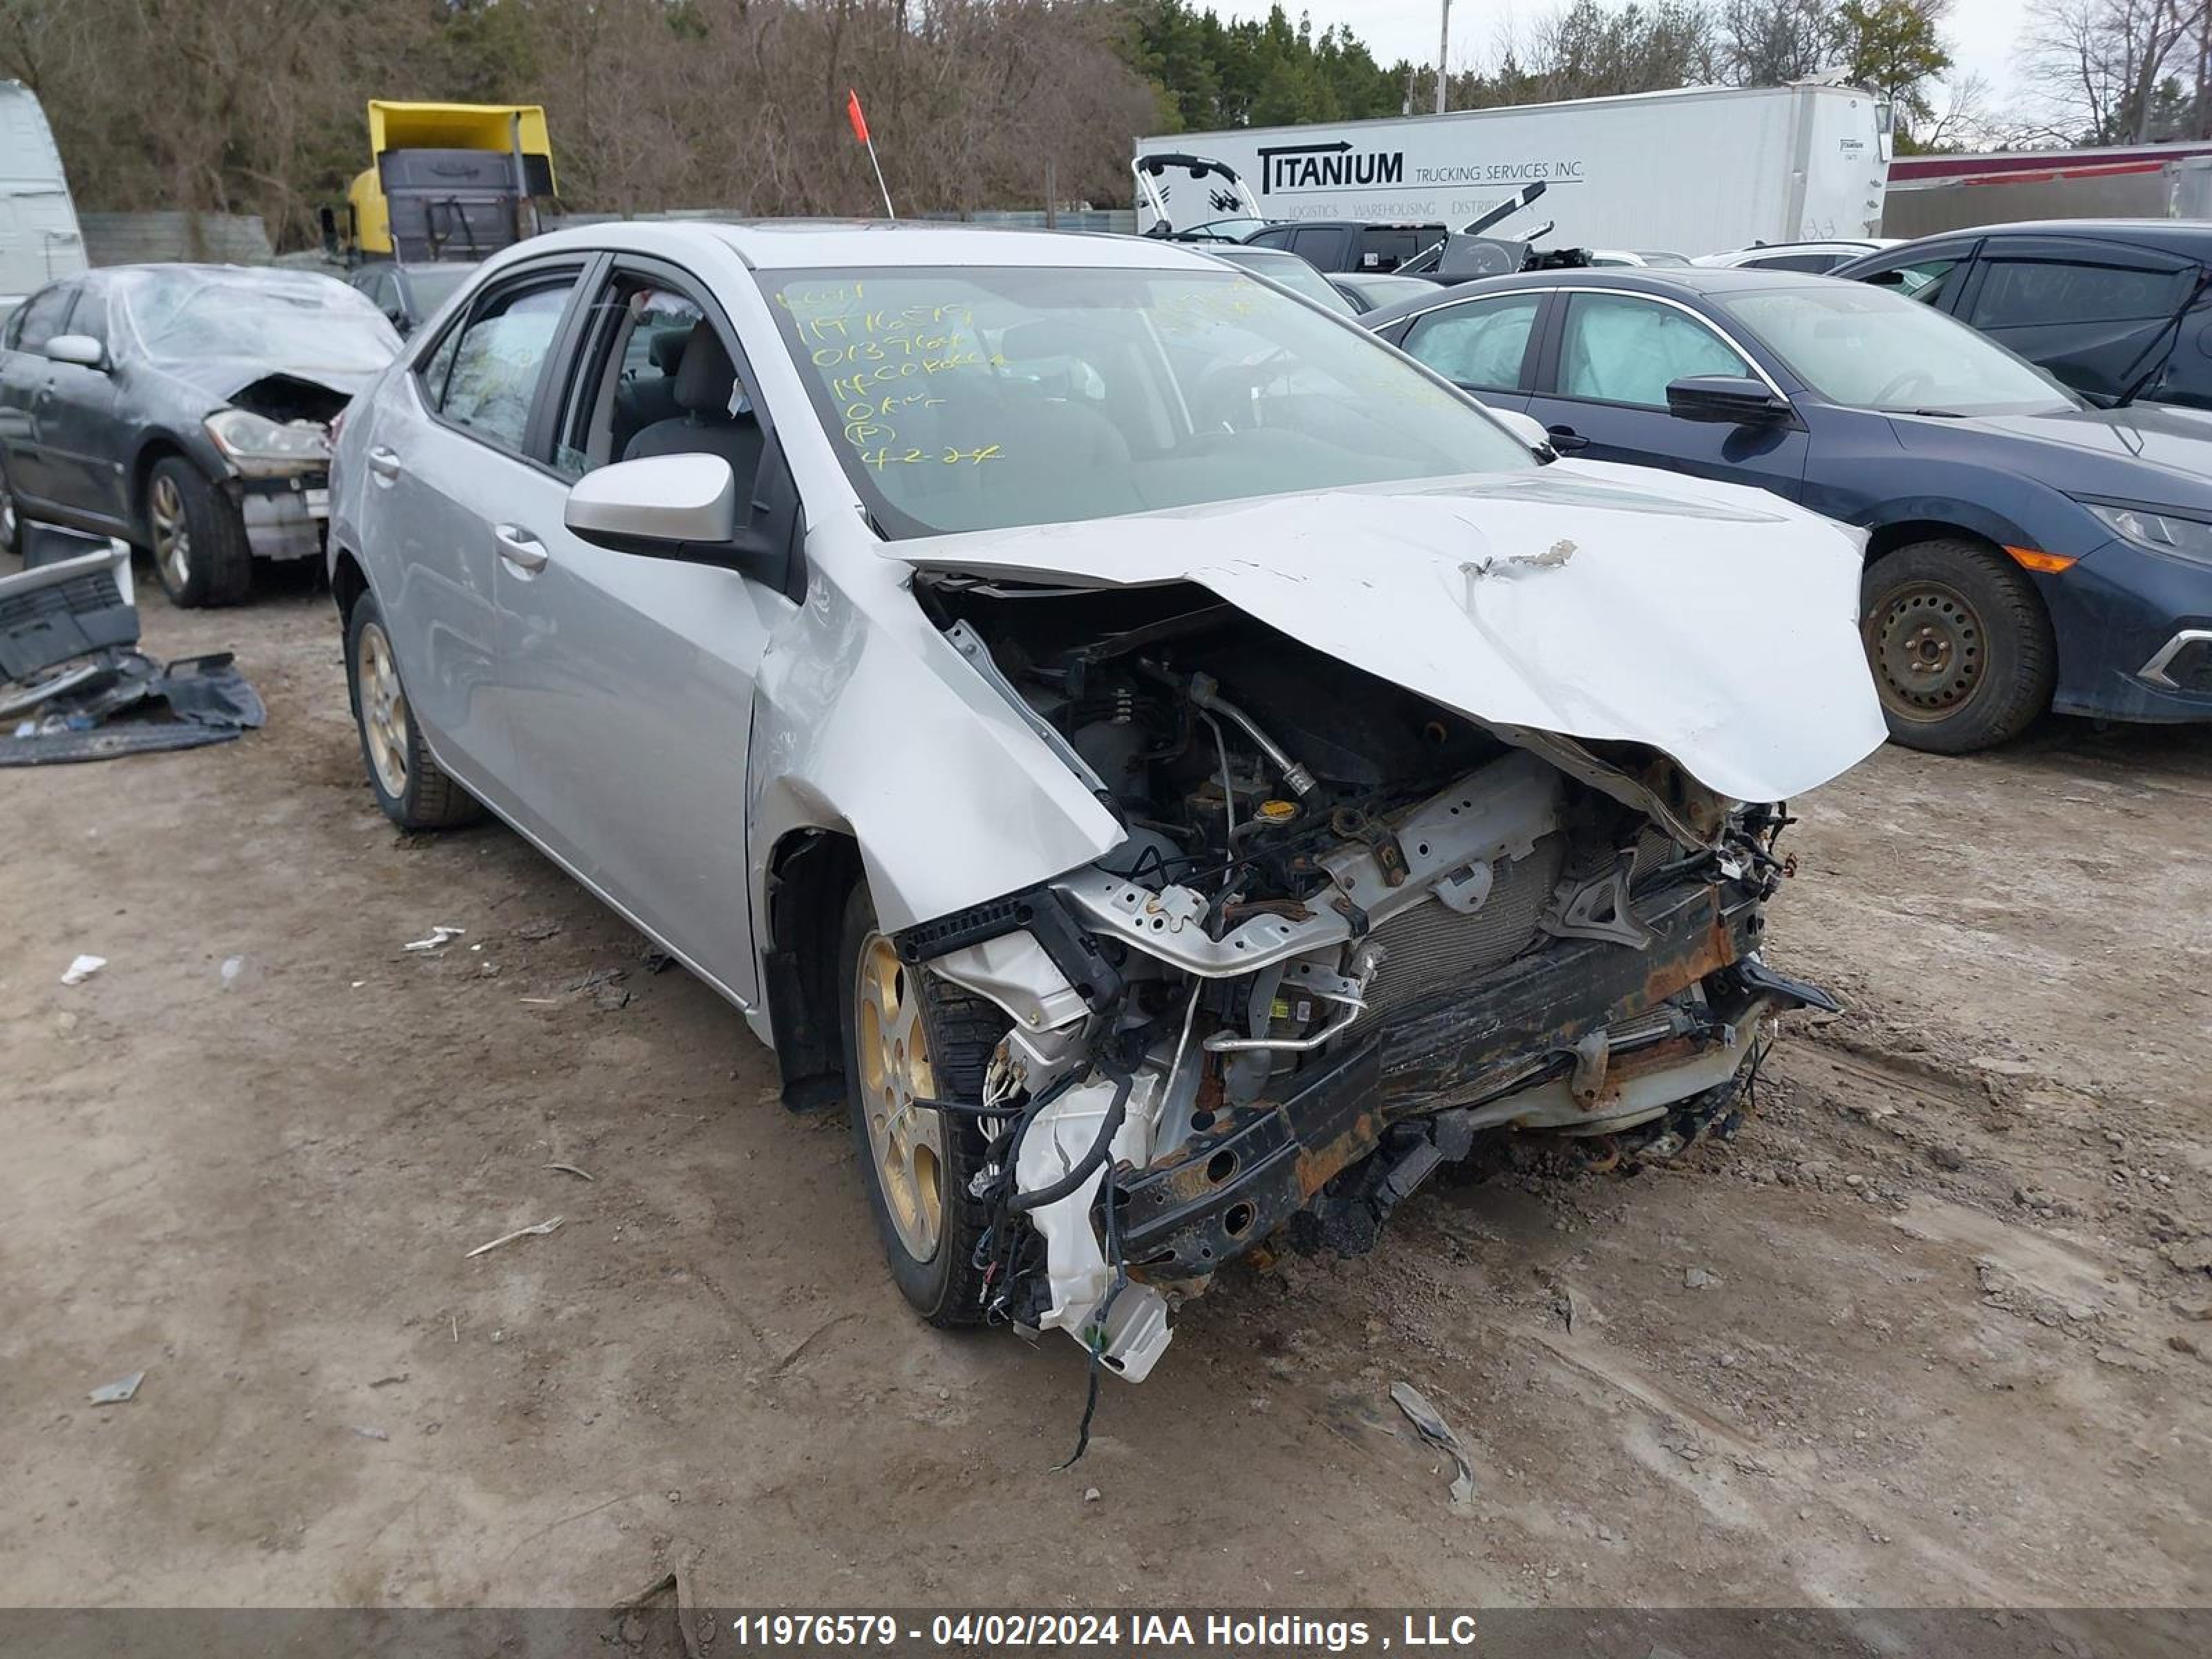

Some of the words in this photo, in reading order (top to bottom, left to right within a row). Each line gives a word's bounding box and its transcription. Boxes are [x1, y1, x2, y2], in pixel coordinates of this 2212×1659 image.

[1258, 141, 1403, 194] TITANIUM
[1416, 165, 1481, 182] TRUCKING
[1487, 162, 1549, 180] SERVICES
[1555, 161, 1585, 177] INC.
[1352, 200, 1436, 217] WAREHOUSING
